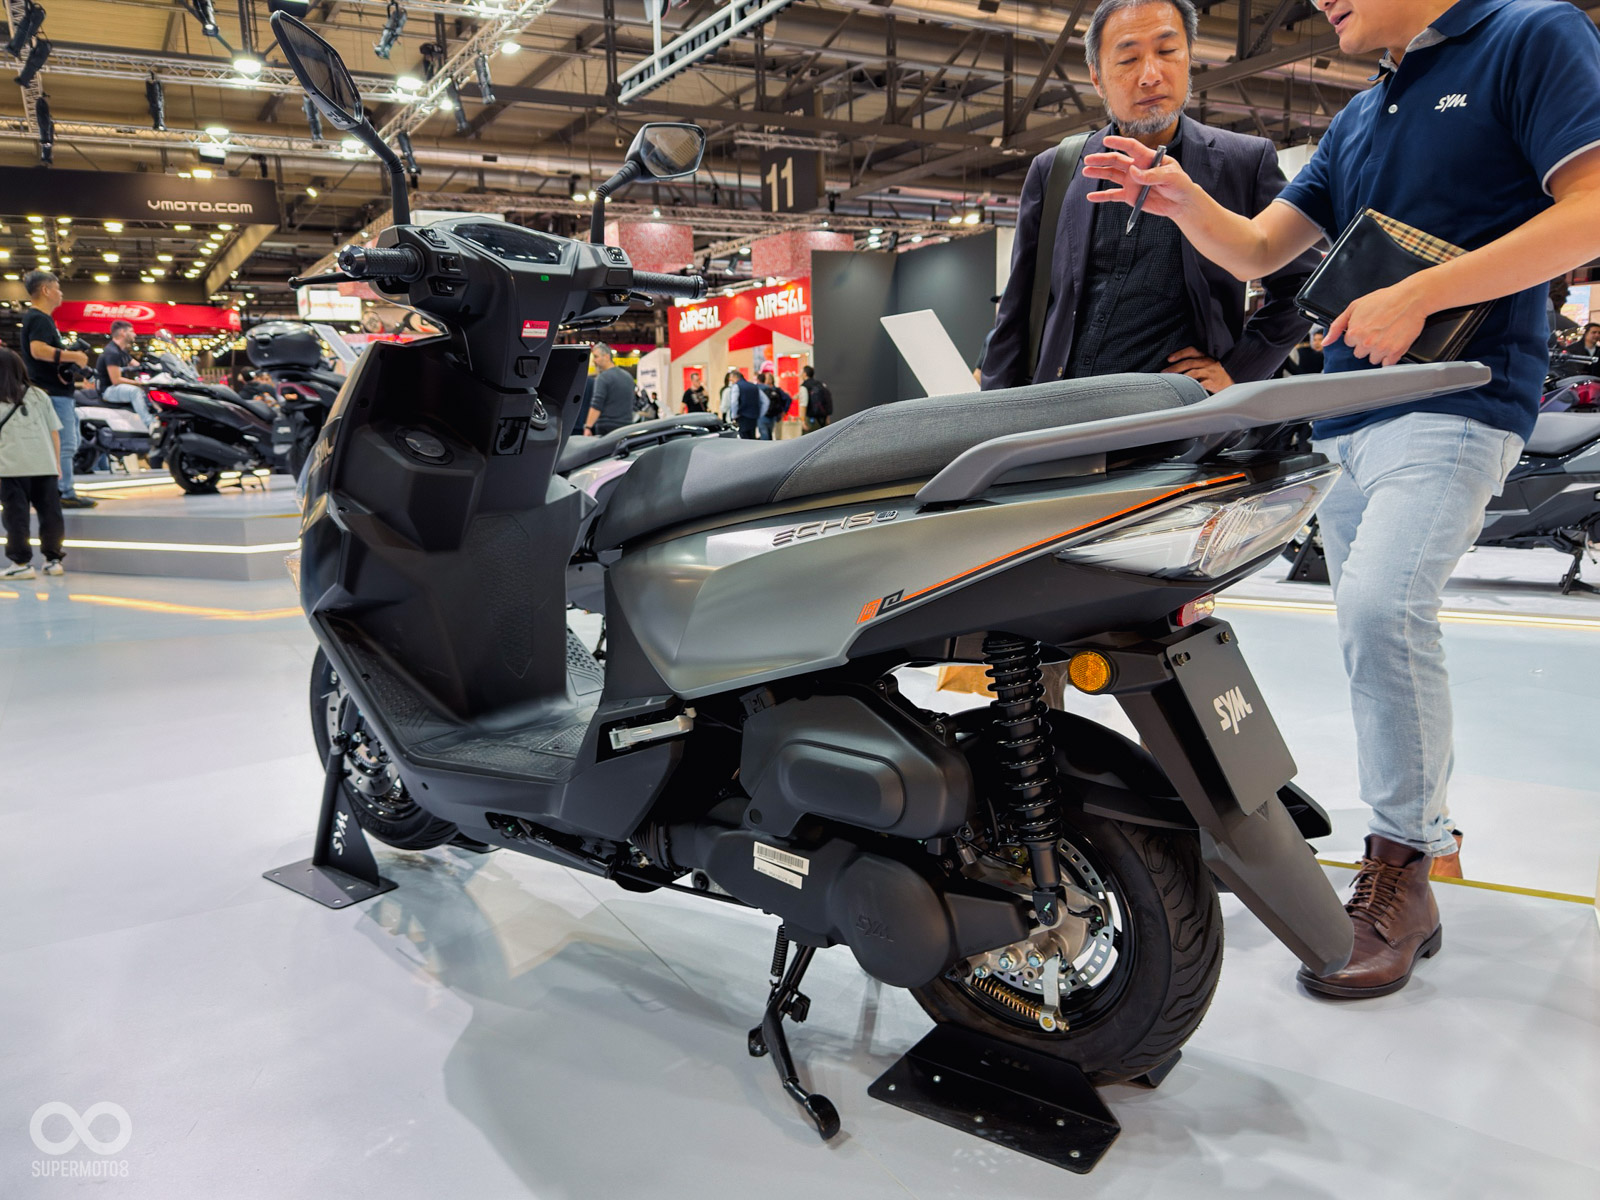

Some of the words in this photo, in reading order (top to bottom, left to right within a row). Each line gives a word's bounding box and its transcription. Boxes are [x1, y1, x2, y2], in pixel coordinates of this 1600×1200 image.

[1434, 93, 1468, 112] SYM
[147, 199, 253, 213] VMOTO.COM
[765, 157, 794, 212] 11
[1213, 685, 1253, 735] SYM
[332, 810, 349, 856] SYM
